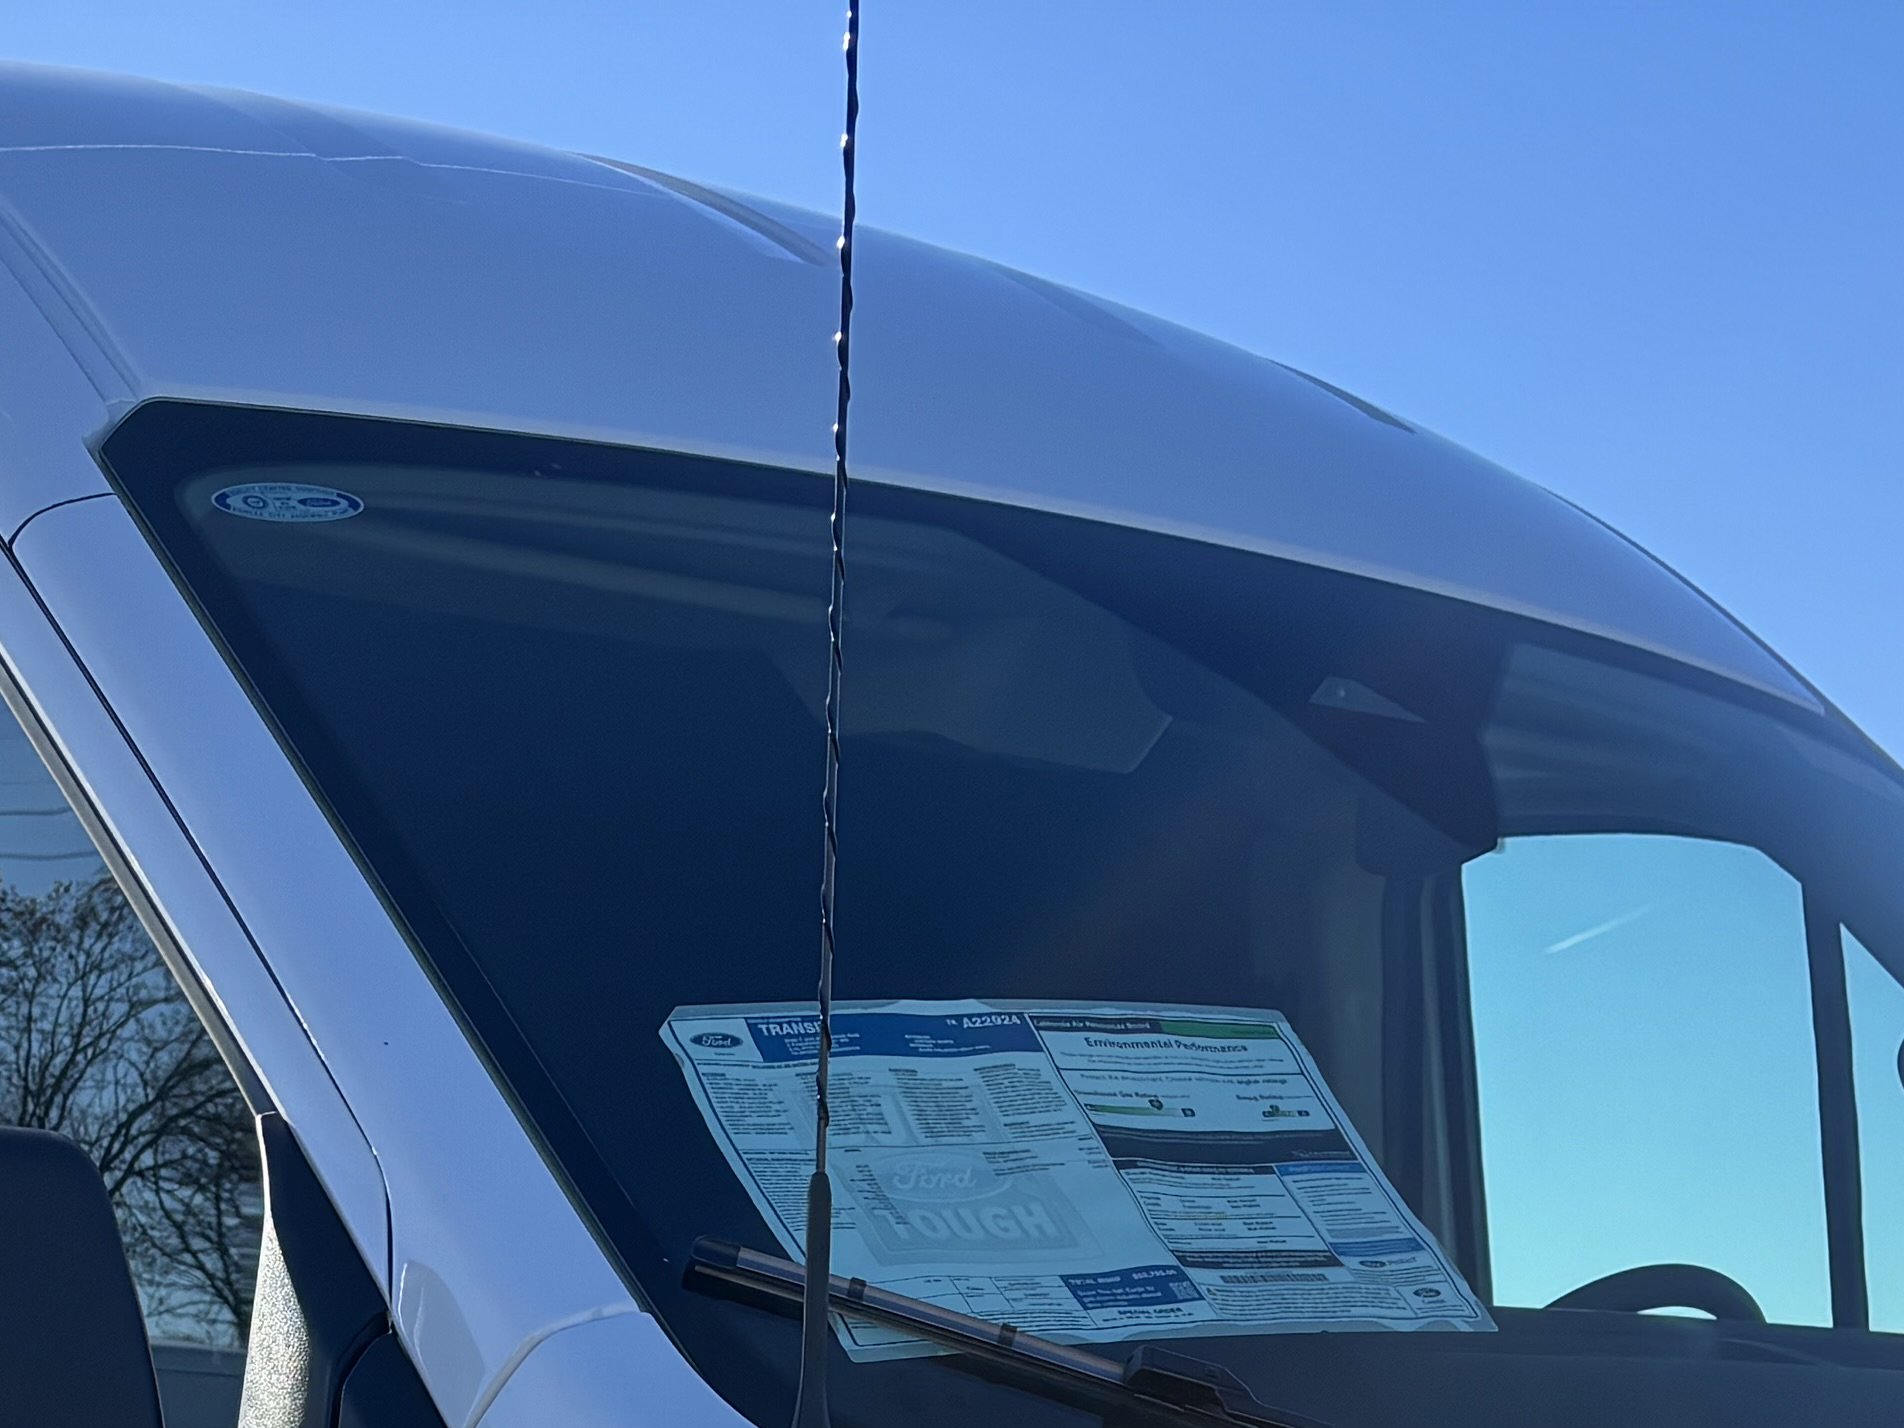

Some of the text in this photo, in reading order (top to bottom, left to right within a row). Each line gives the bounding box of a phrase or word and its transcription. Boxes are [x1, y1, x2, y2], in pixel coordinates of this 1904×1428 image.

[757, 1021, 822, 1036] TRANSI
[1083, 1036, 1249, 1053] Environmental Performance
[875, 1200, 1062, 1241] TOUGH
